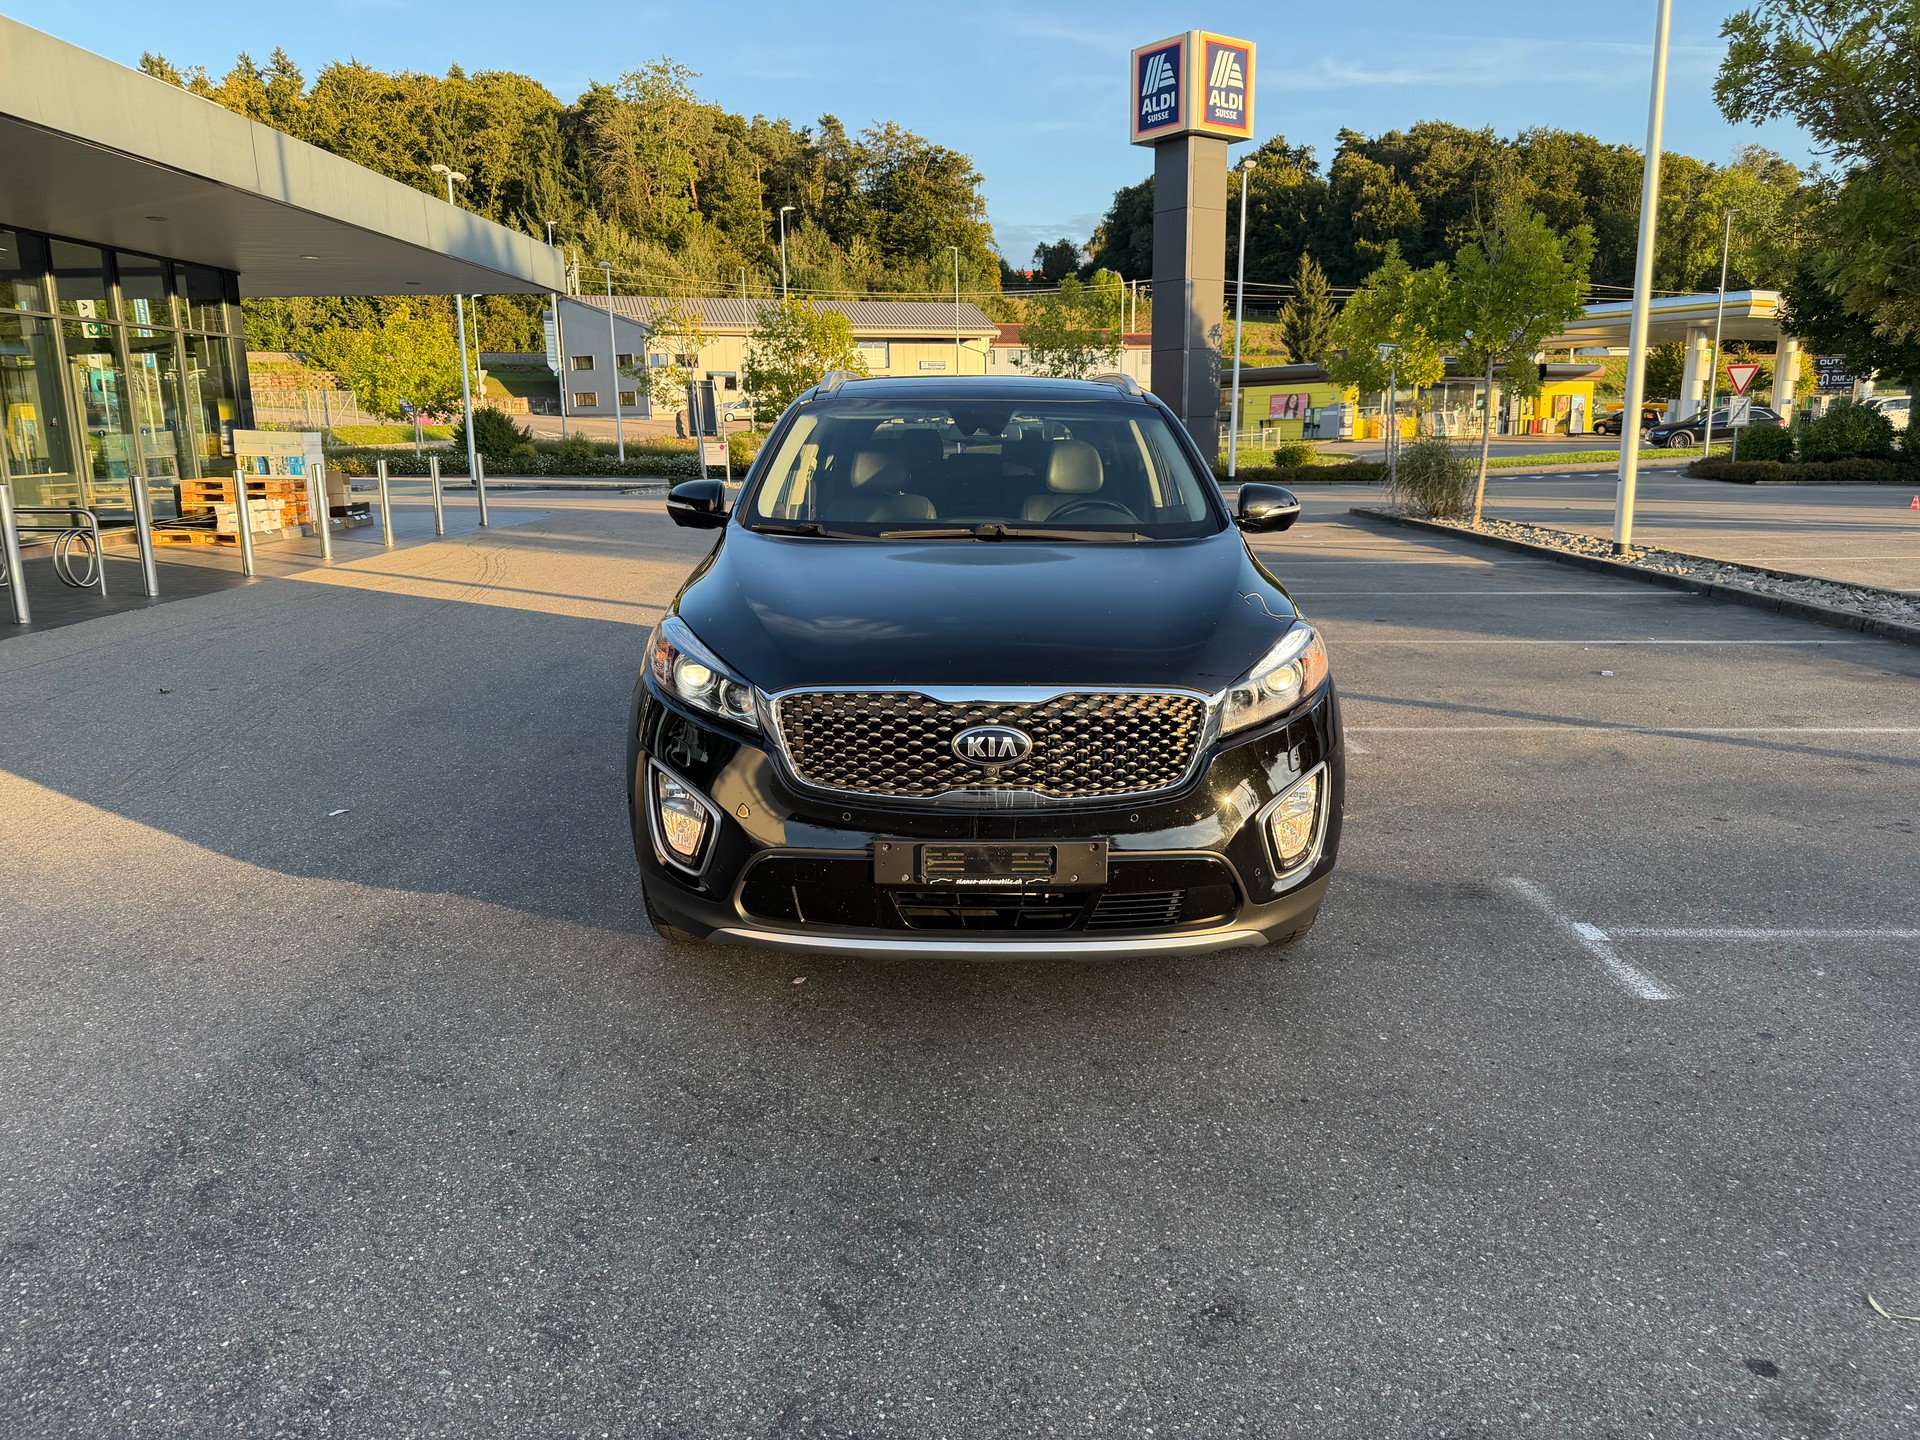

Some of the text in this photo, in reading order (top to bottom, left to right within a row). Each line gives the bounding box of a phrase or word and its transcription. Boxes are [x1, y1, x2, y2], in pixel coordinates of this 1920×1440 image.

[1142, 91, 1176, 115] ALDI
[1209, 90, 1243, 110] ALDI
[1147, 111, 1169, 123] SUISSE
[1215, 108, 1237, 119] SUISSE
[967, 736, 1018, 757] KIA
